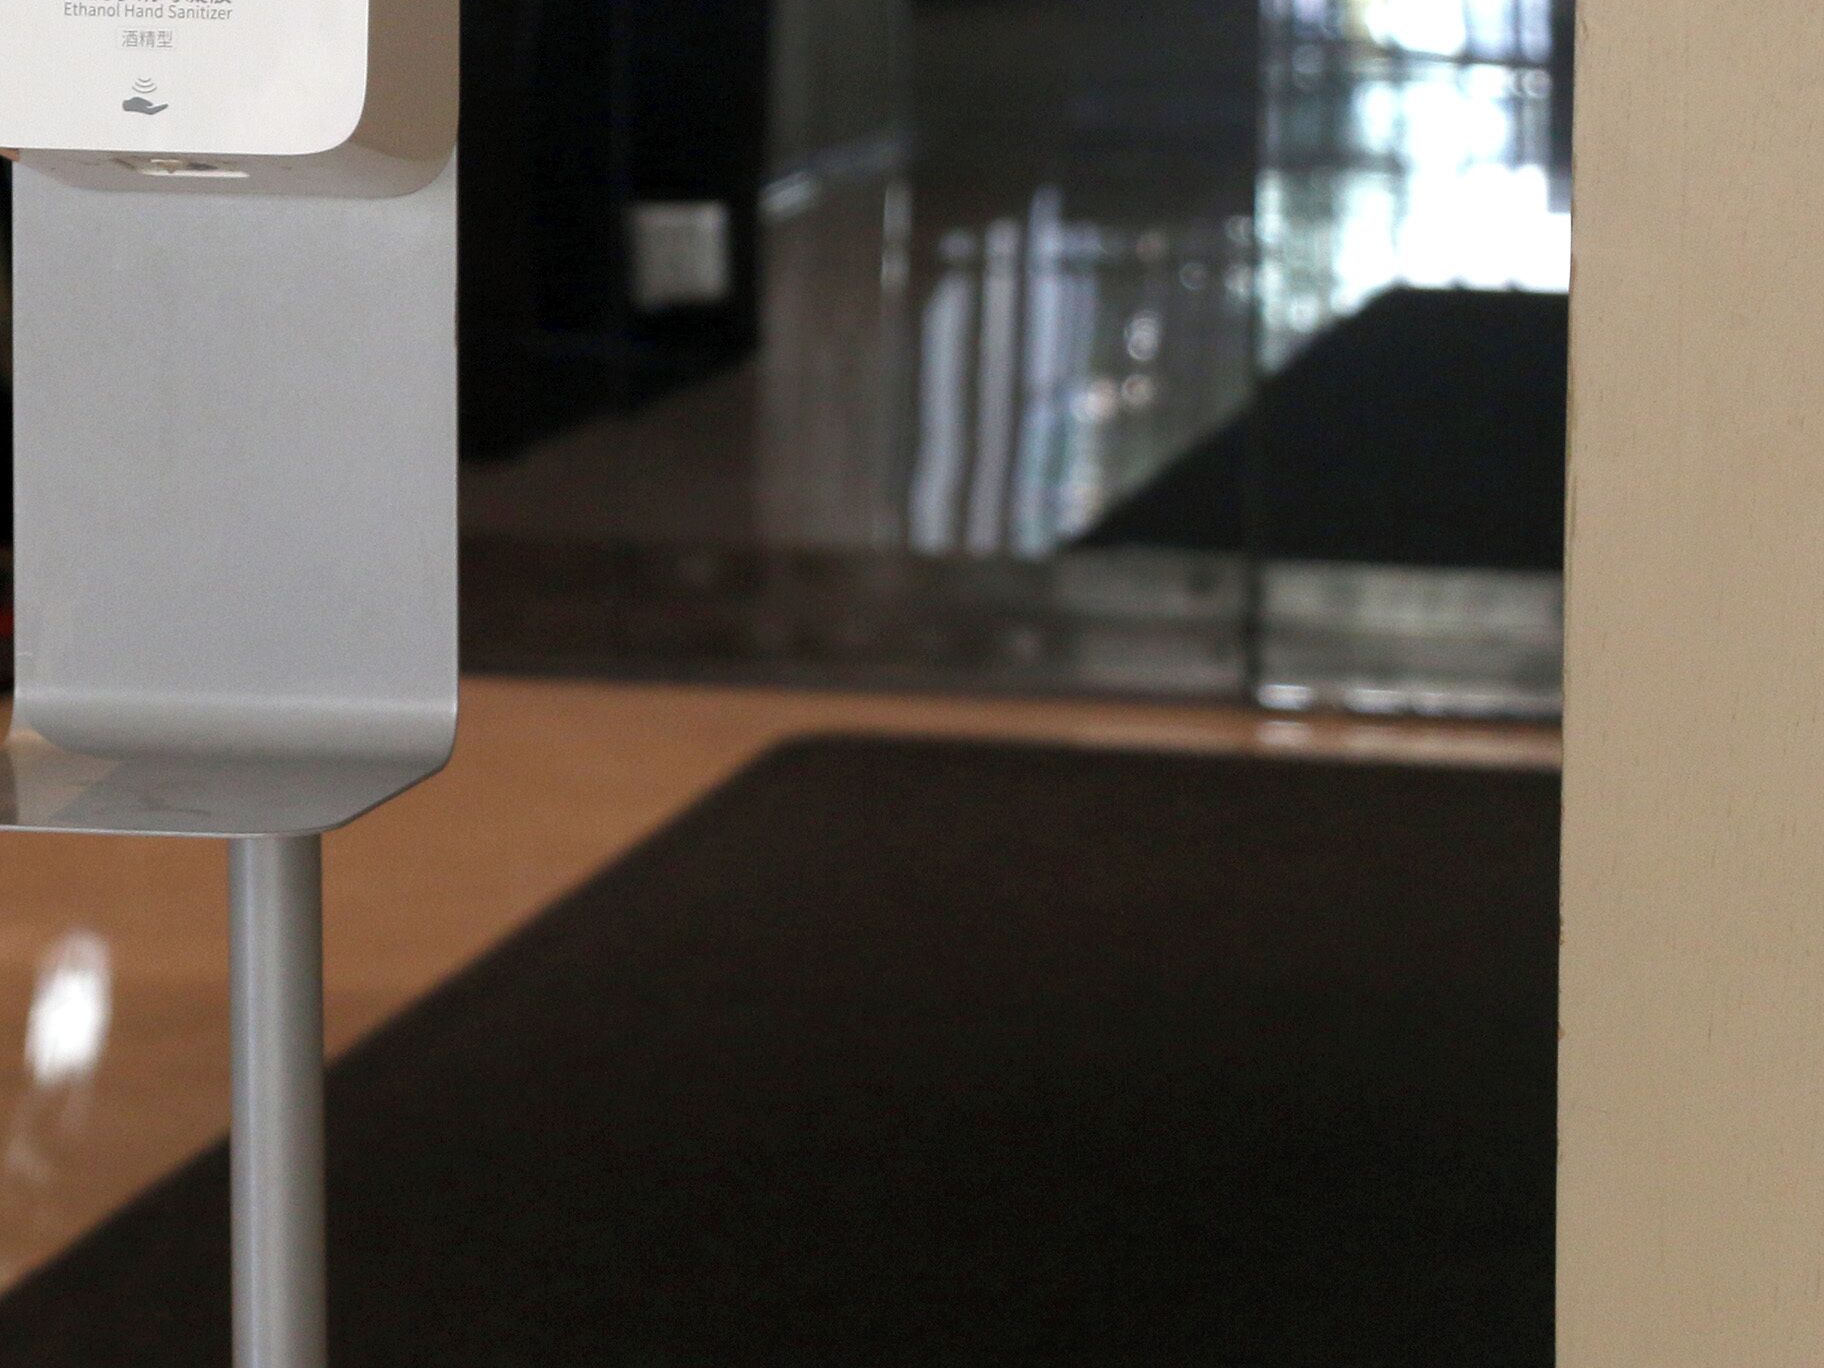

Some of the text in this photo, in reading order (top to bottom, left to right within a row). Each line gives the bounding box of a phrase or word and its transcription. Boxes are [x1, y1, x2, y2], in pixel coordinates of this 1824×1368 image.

[64, 2, 233, 20] Ethanol Hand Sanitizer
[121, 30, 173, 48] 酒精型
